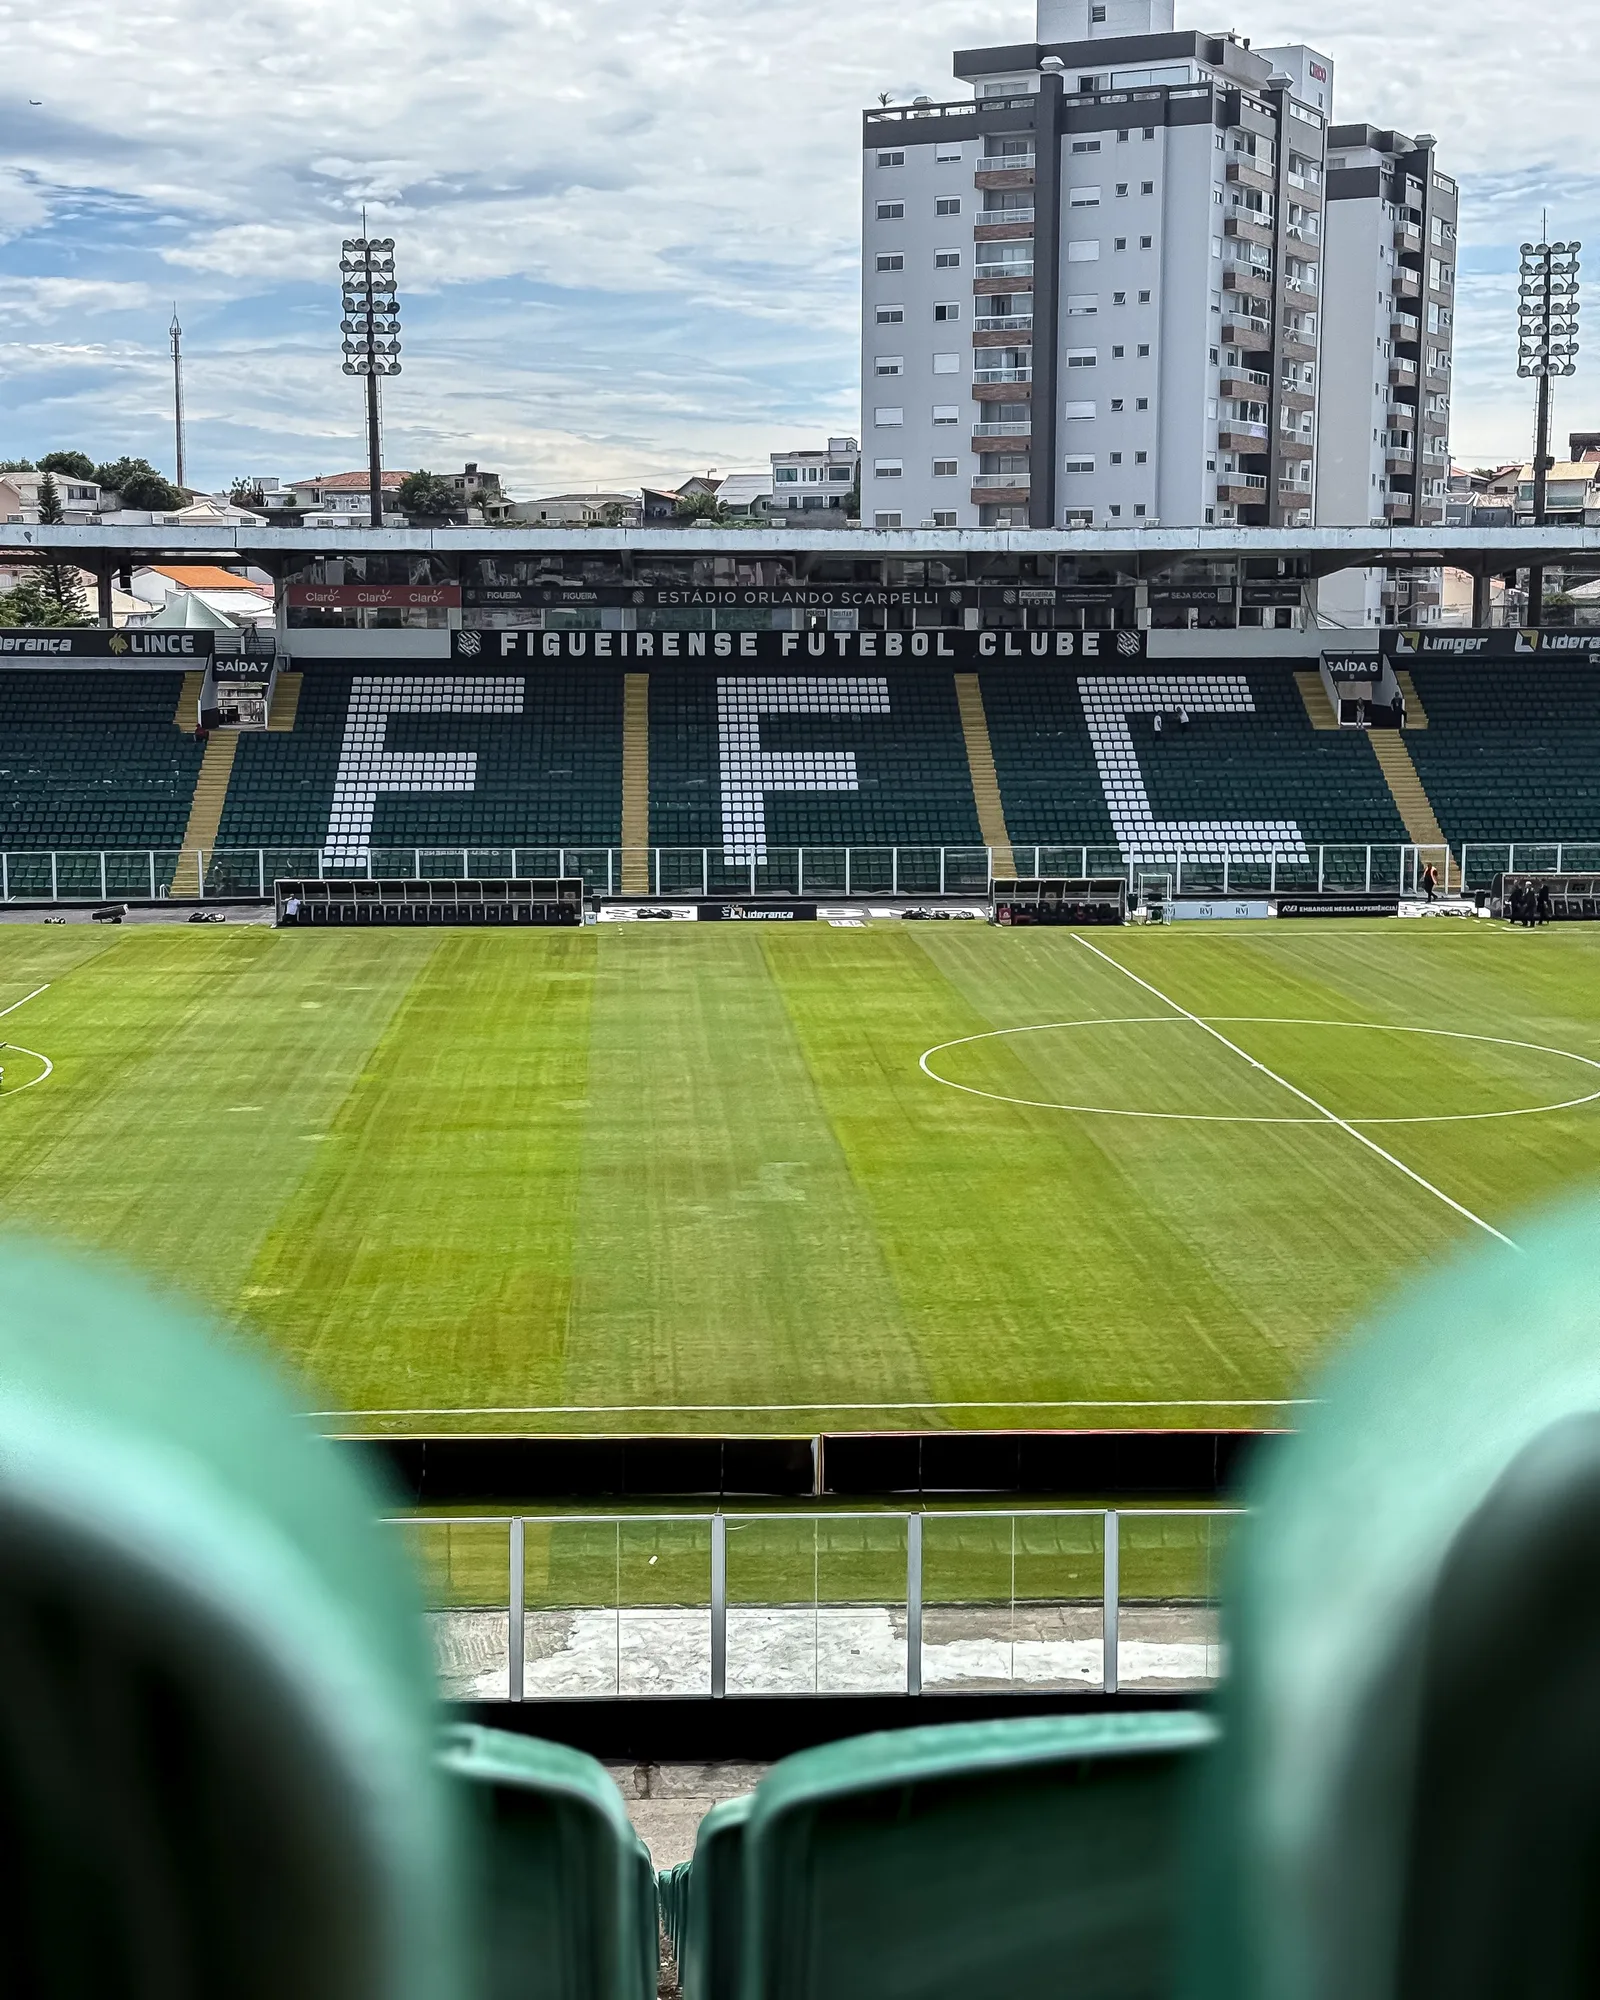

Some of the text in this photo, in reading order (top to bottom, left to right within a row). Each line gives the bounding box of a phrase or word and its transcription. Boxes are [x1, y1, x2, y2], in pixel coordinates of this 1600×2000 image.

[305, 590, 336, 602] Claro
[357, 591, 388, 602] Claro
[409, 592, 440, 603] Claro
[486, 591, 522, 600] FIGUEIRA
[562, 591, 598, 600] FIGUEIRA
[657, 589, 939, 605] ESTÁDIO ORLANDO SCARPELLI
[1171, 591, 1191, 599] SEJA
[0, 635, 72, 654] erança
[131, 634, 195, 653] LINCE
[501, 632, 1100, 657] FIGUEIRENSE FUTEBOL CLUBE
[1423, 635, 1489, 654] Limger
[216, 658, 269, 673] SAÍDA 7
[1328, 659, 1378, 672] SAÍDA 6
[743, 909, 794, 920] Liderança
[1199, 907, 1213, 916] RVJ
[1235, 907, 1249, 916] RVJ
